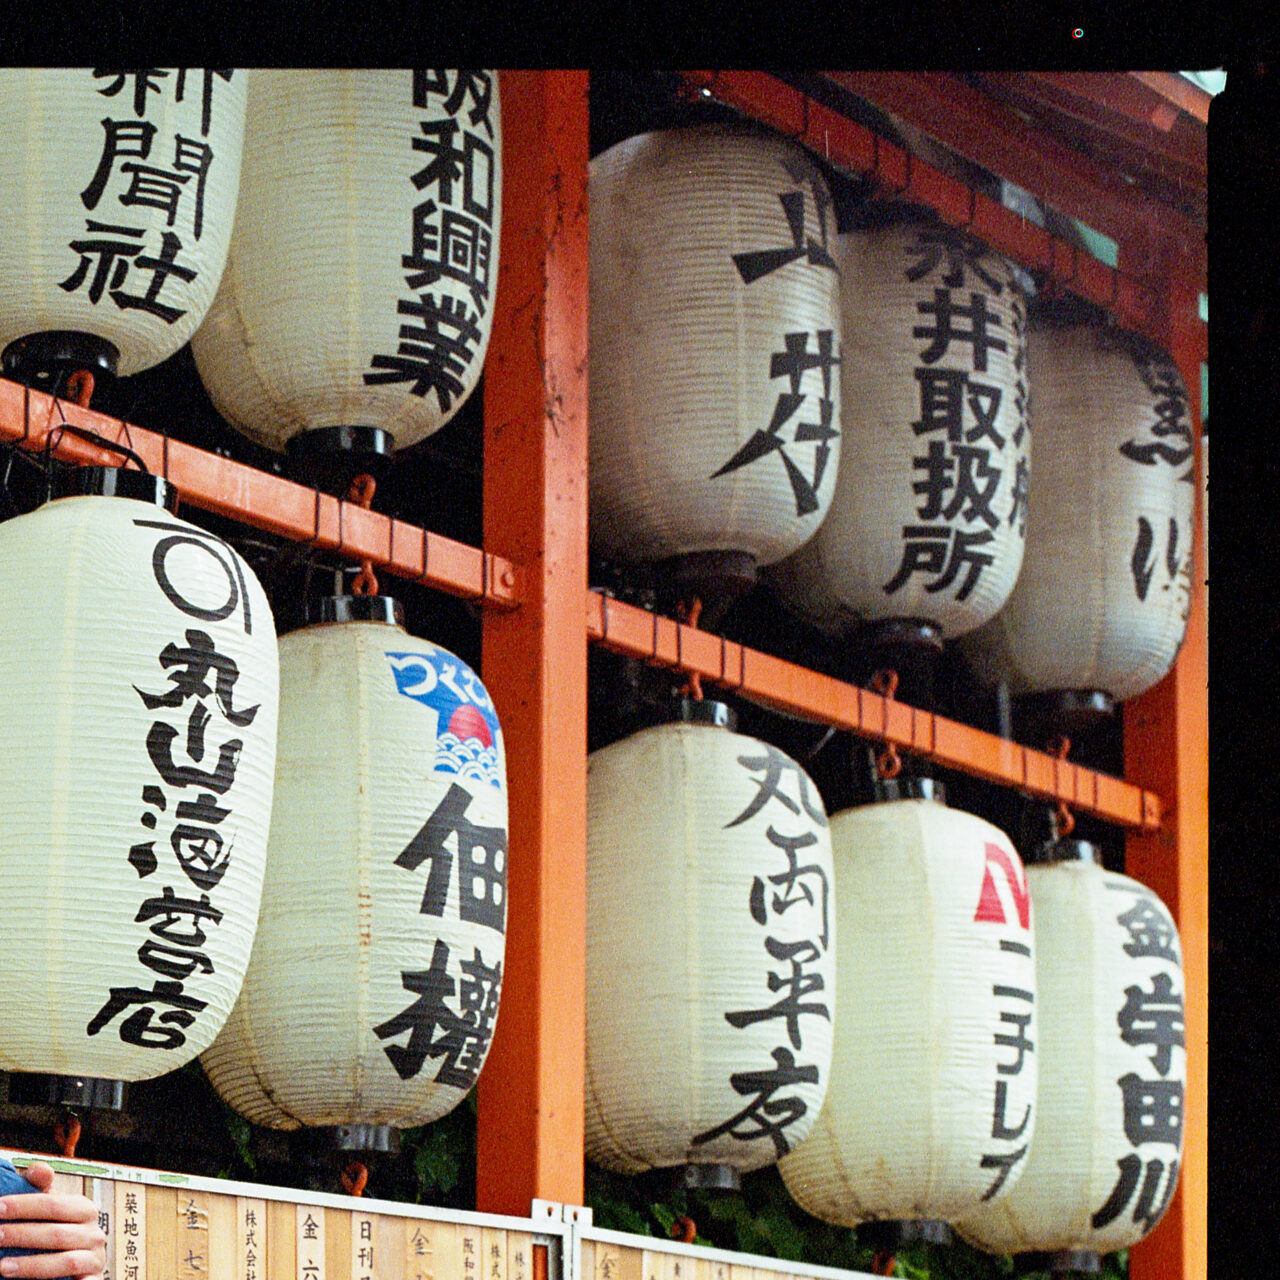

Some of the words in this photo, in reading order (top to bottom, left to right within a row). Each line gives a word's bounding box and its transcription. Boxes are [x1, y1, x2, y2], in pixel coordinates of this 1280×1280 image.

[184, 1201, 208, 1230] 金
[302, 1214, 320, 1240] 金
[411, 1228, 430, 1256] 金
